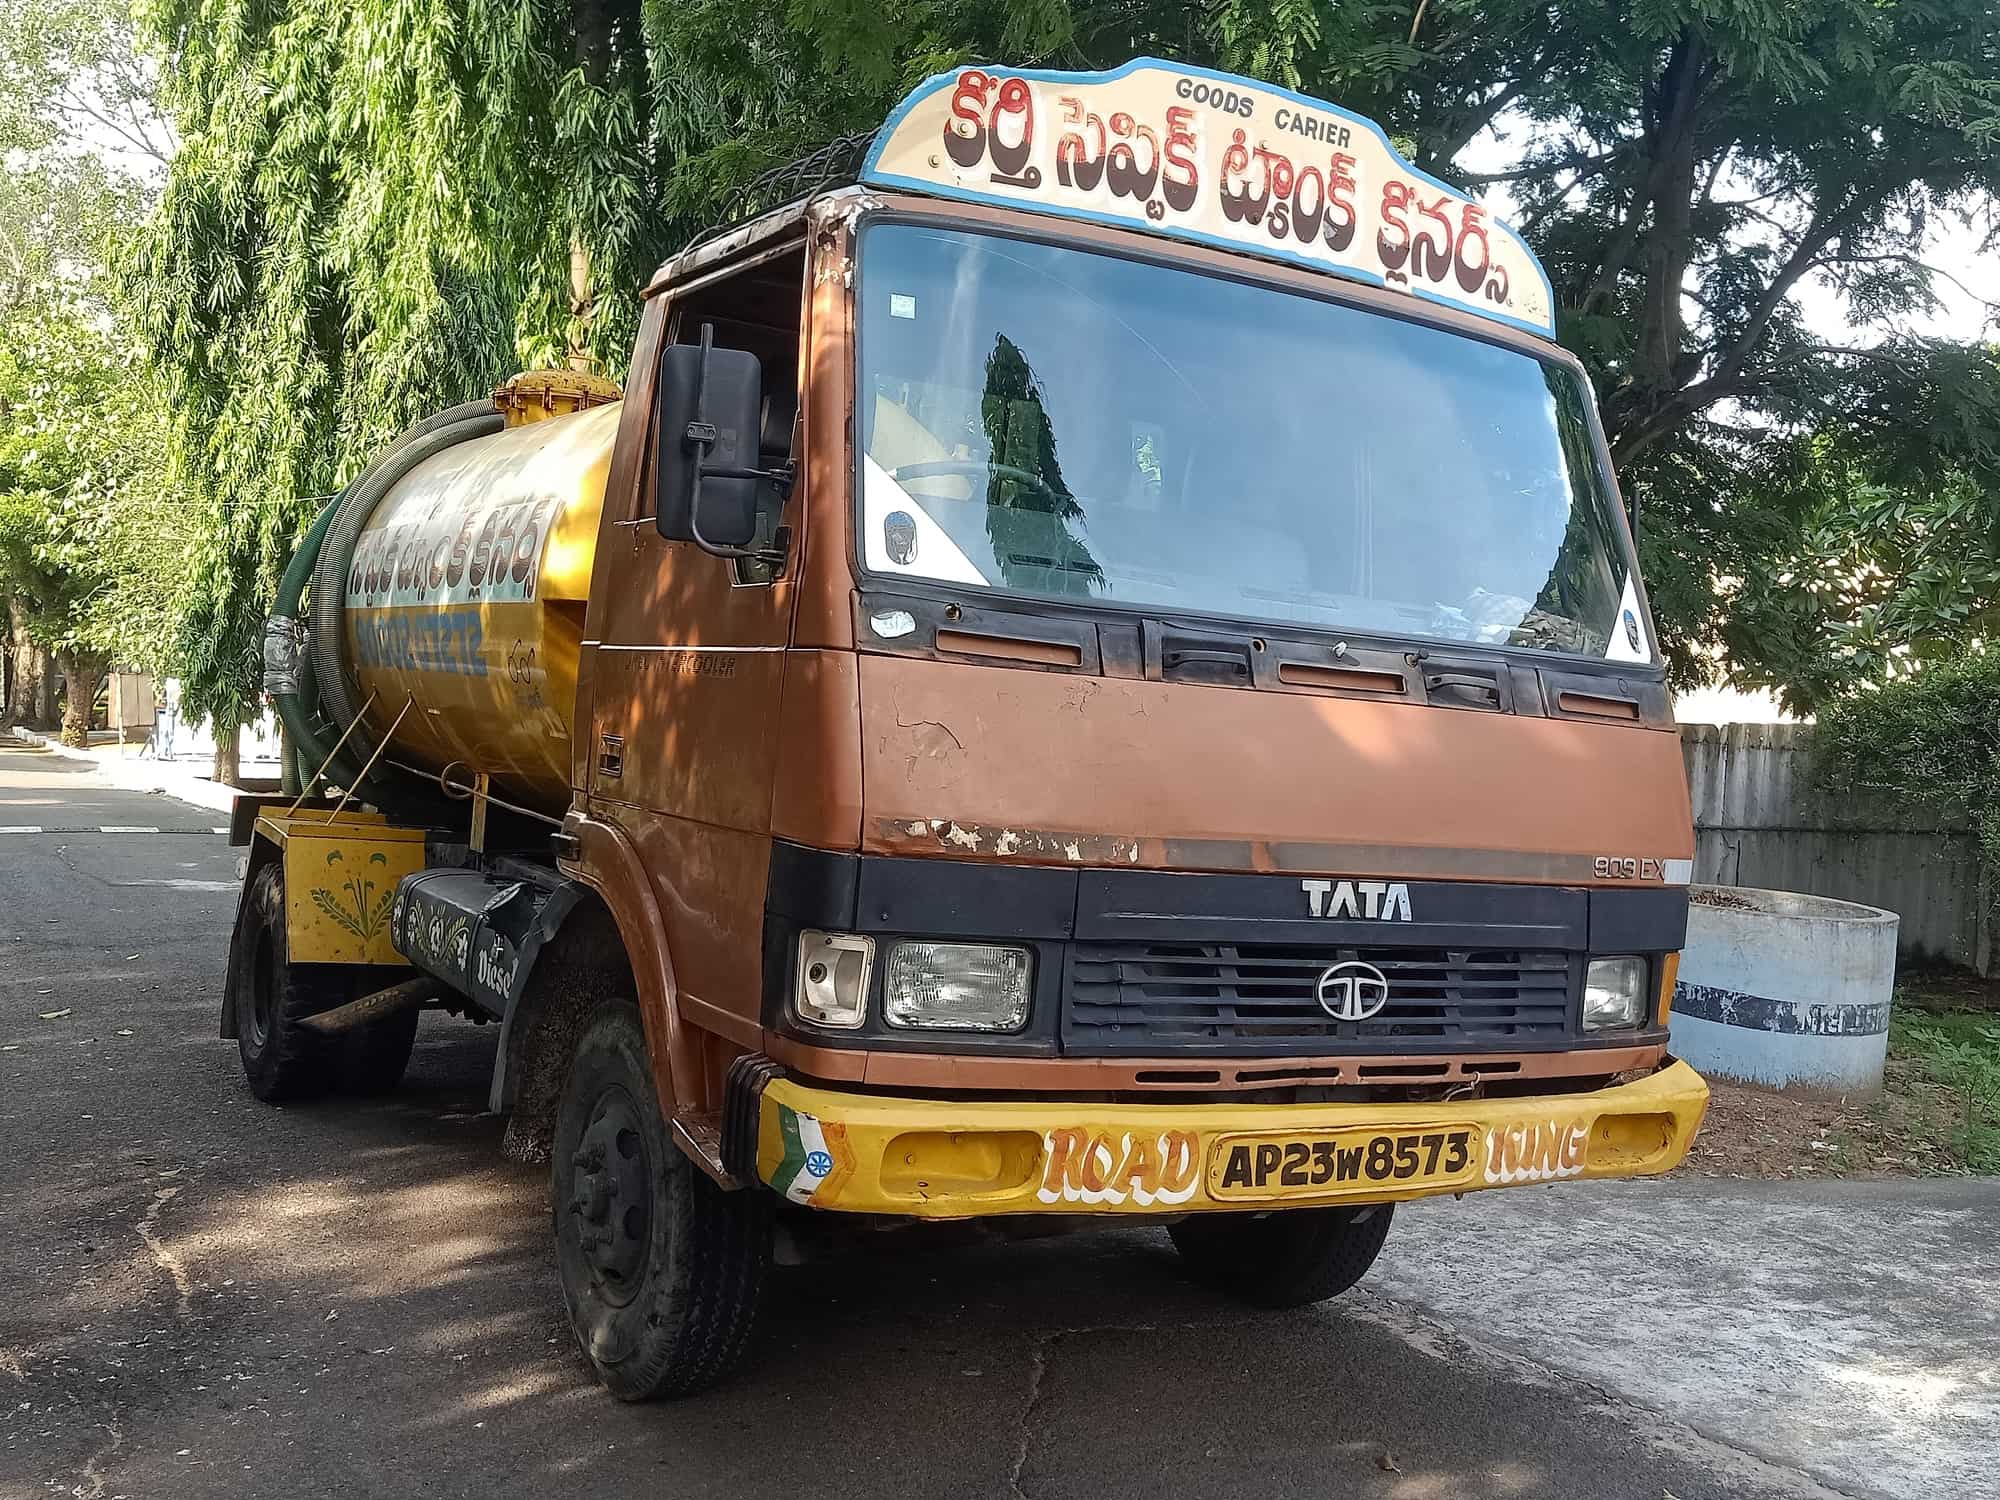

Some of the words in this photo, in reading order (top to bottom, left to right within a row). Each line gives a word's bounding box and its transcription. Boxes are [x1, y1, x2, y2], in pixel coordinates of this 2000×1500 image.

[1175, 78, 1255, 119] GOODS
[1274, 107, 1352, 149] CARIER
[1593, 855, 1636, 880] 909
[1639, 857, 1665, 881] EX
[1301, 879, 1413, 922] TATA
[1036, 1126, 1200, 1206] ROAD
[1483, 1119, 1589, 1184] KING
